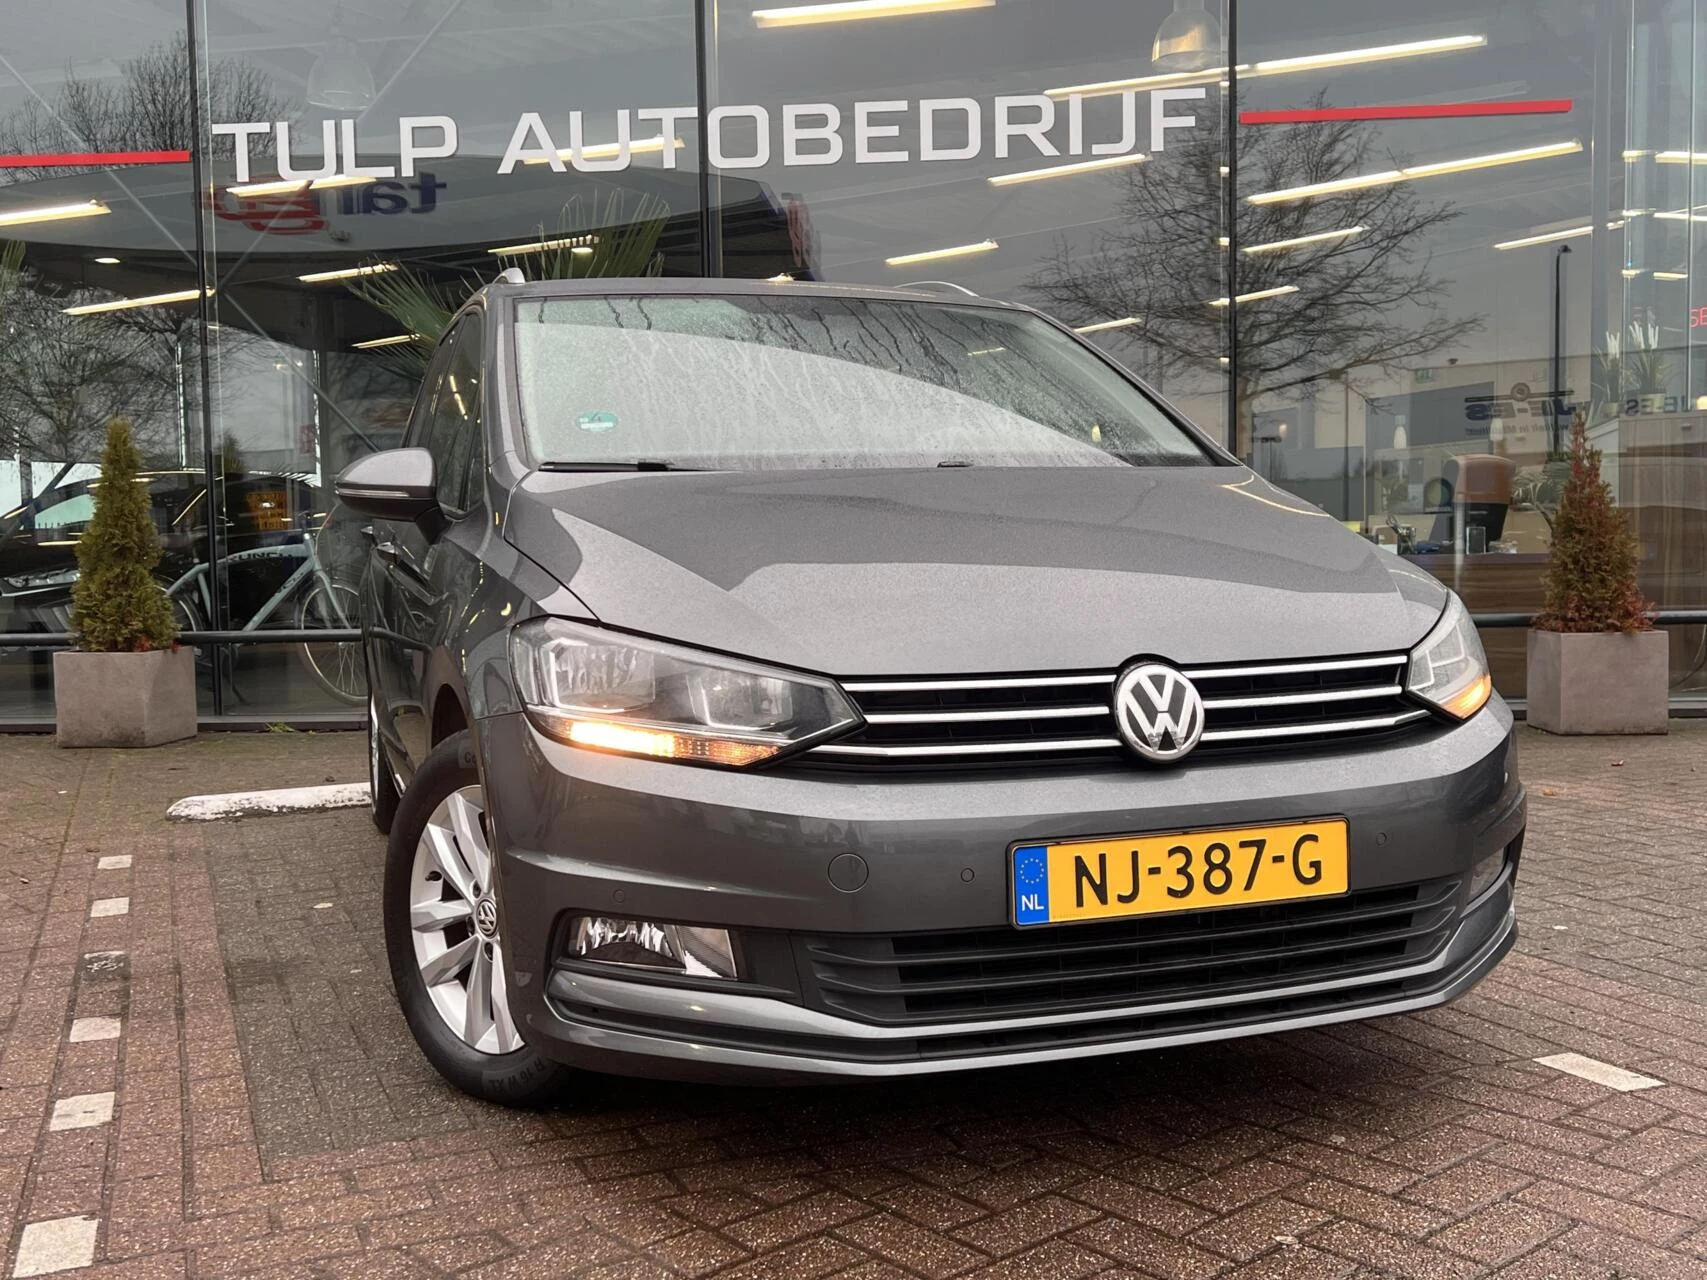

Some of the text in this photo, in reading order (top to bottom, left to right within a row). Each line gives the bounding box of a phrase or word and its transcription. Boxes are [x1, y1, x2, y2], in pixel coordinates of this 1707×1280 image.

[212, 87, 1206, 182] TULP AUTOBEDRIJF
[1021, 894, 1044, 912] NL
[1073, 833, 1322, 908] NJ-387-G
